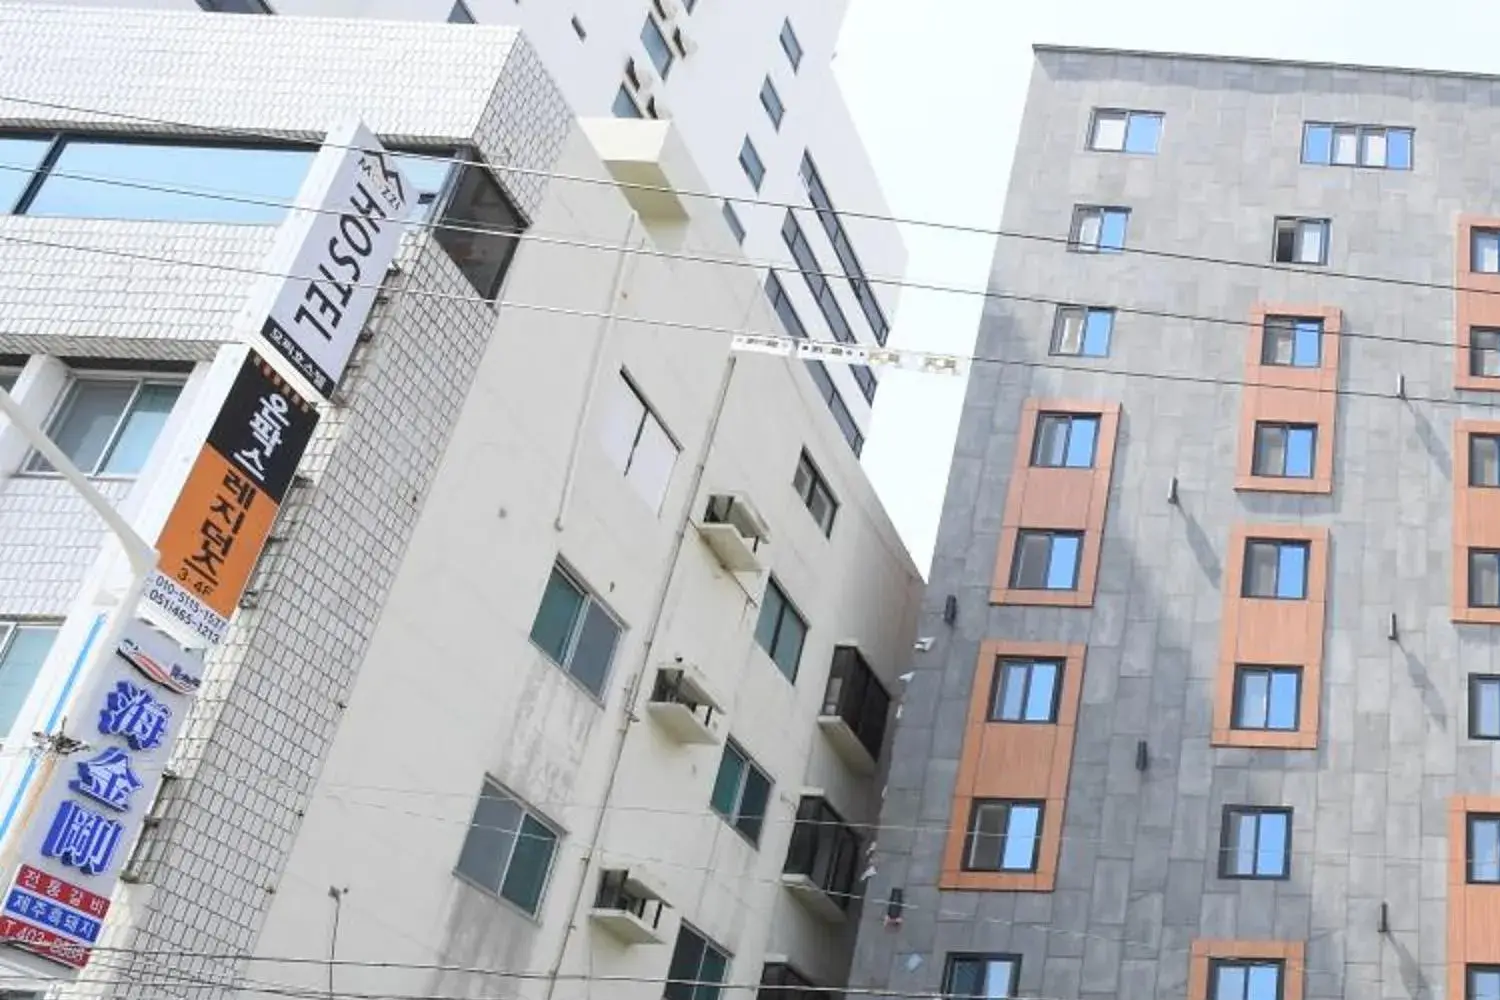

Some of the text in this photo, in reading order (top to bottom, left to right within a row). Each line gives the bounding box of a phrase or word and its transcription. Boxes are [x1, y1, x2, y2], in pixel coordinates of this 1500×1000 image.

[293, 182, 387, 342] HOSTEL
[183, 469, 258, 587] 레지던스
[40, 679, 172, 876] 海金剛
